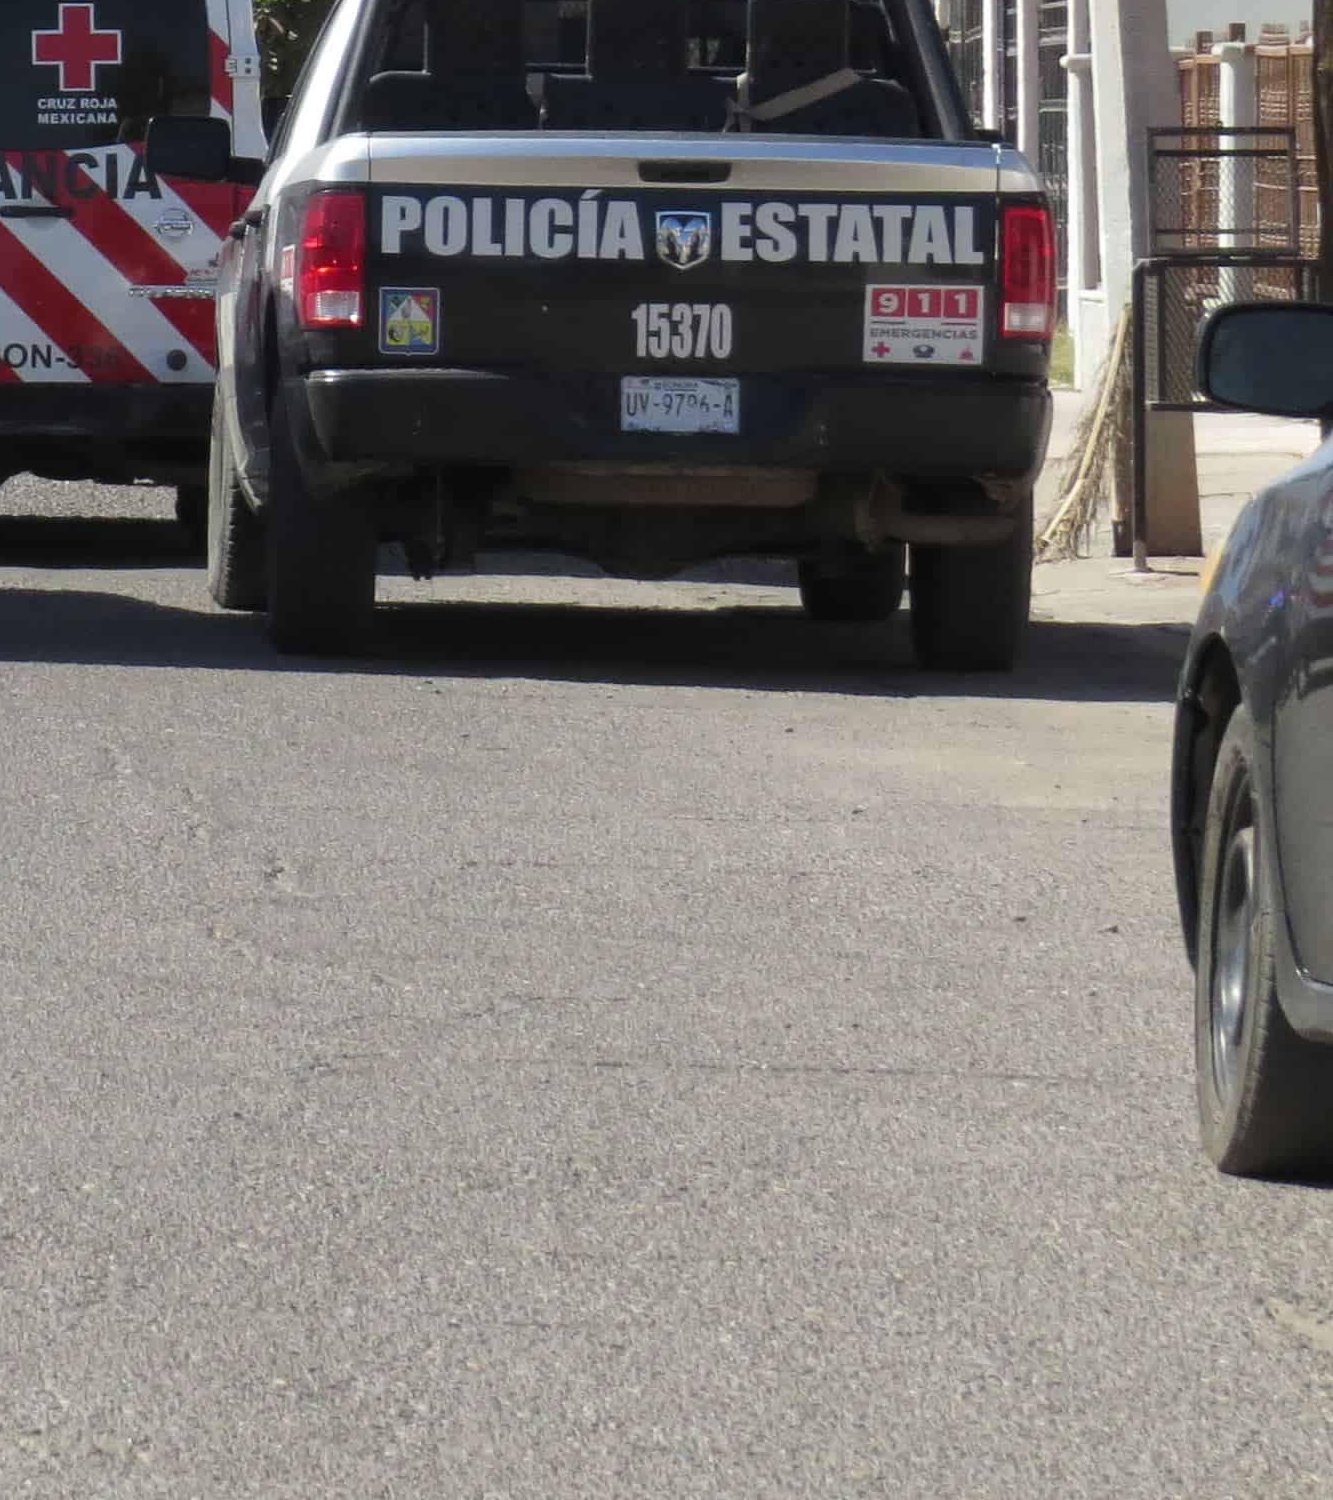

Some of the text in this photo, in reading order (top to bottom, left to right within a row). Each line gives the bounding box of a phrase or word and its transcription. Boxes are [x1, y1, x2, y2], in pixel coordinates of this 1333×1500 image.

[37, 98, 118, 109] CRUZ ROJA
[37, 113, 118, 124] MEXICANA
[380, 190, 984, 265] POLICÍA ESTATAL
[878, 292, 968, 315] 911
[631, 303, 732, 359] 15370
[869, 327, 979, 340] EMERGENCIAS
